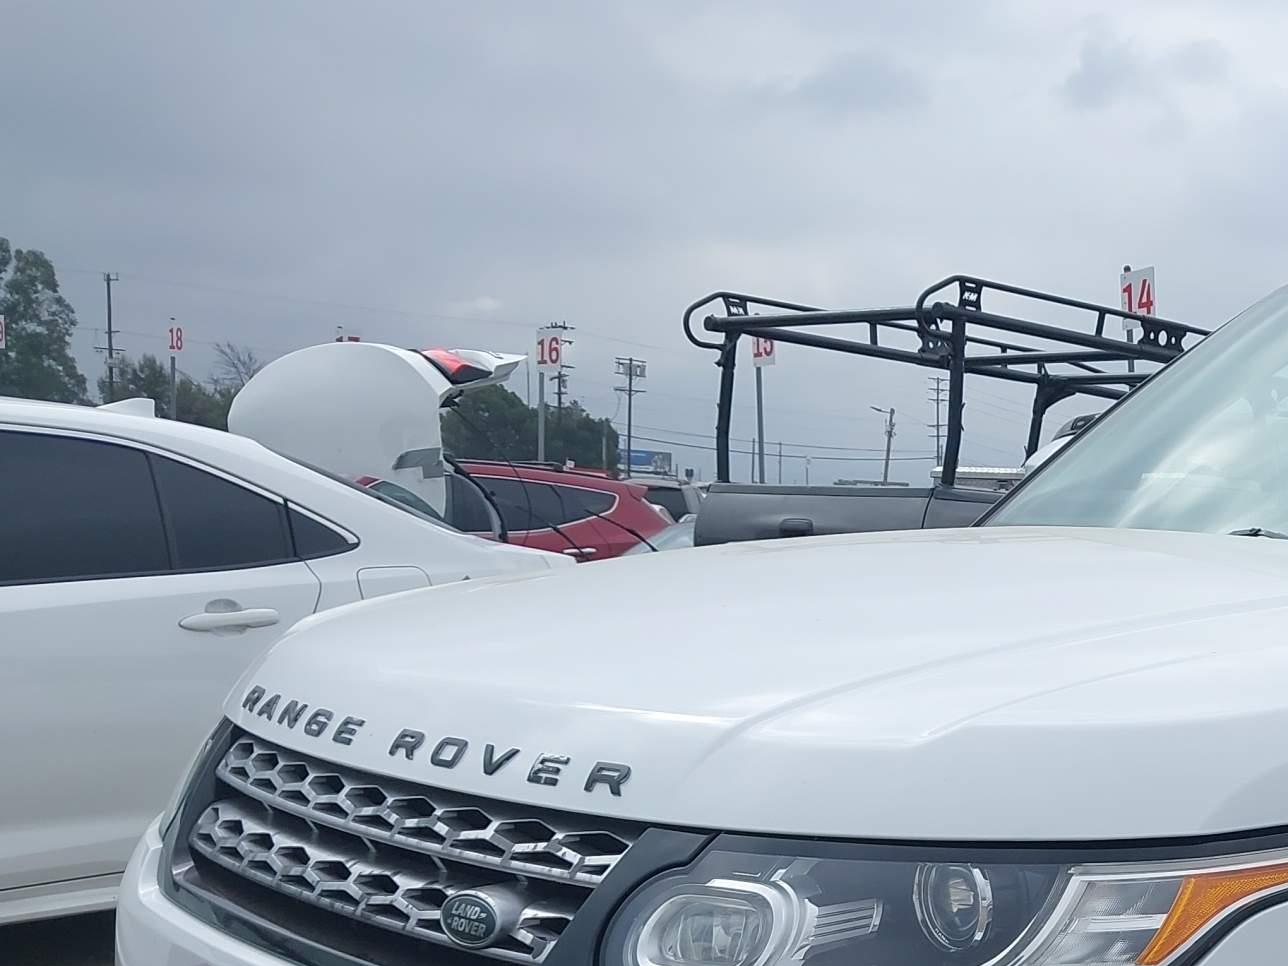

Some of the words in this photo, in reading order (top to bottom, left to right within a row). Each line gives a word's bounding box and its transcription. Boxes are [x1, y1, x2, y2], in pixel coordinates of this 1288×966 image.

[1122, 278, 1154, 316] 14
[168, 327, 184, 351] 18
[536, 336, 560, 365] 16
[241, 684, 366, 746] RANGE
[388, 727, 633, 798] ROVER
[451, 901, 481, 920] LAND
[451, 916, 487, 937] ROVER
